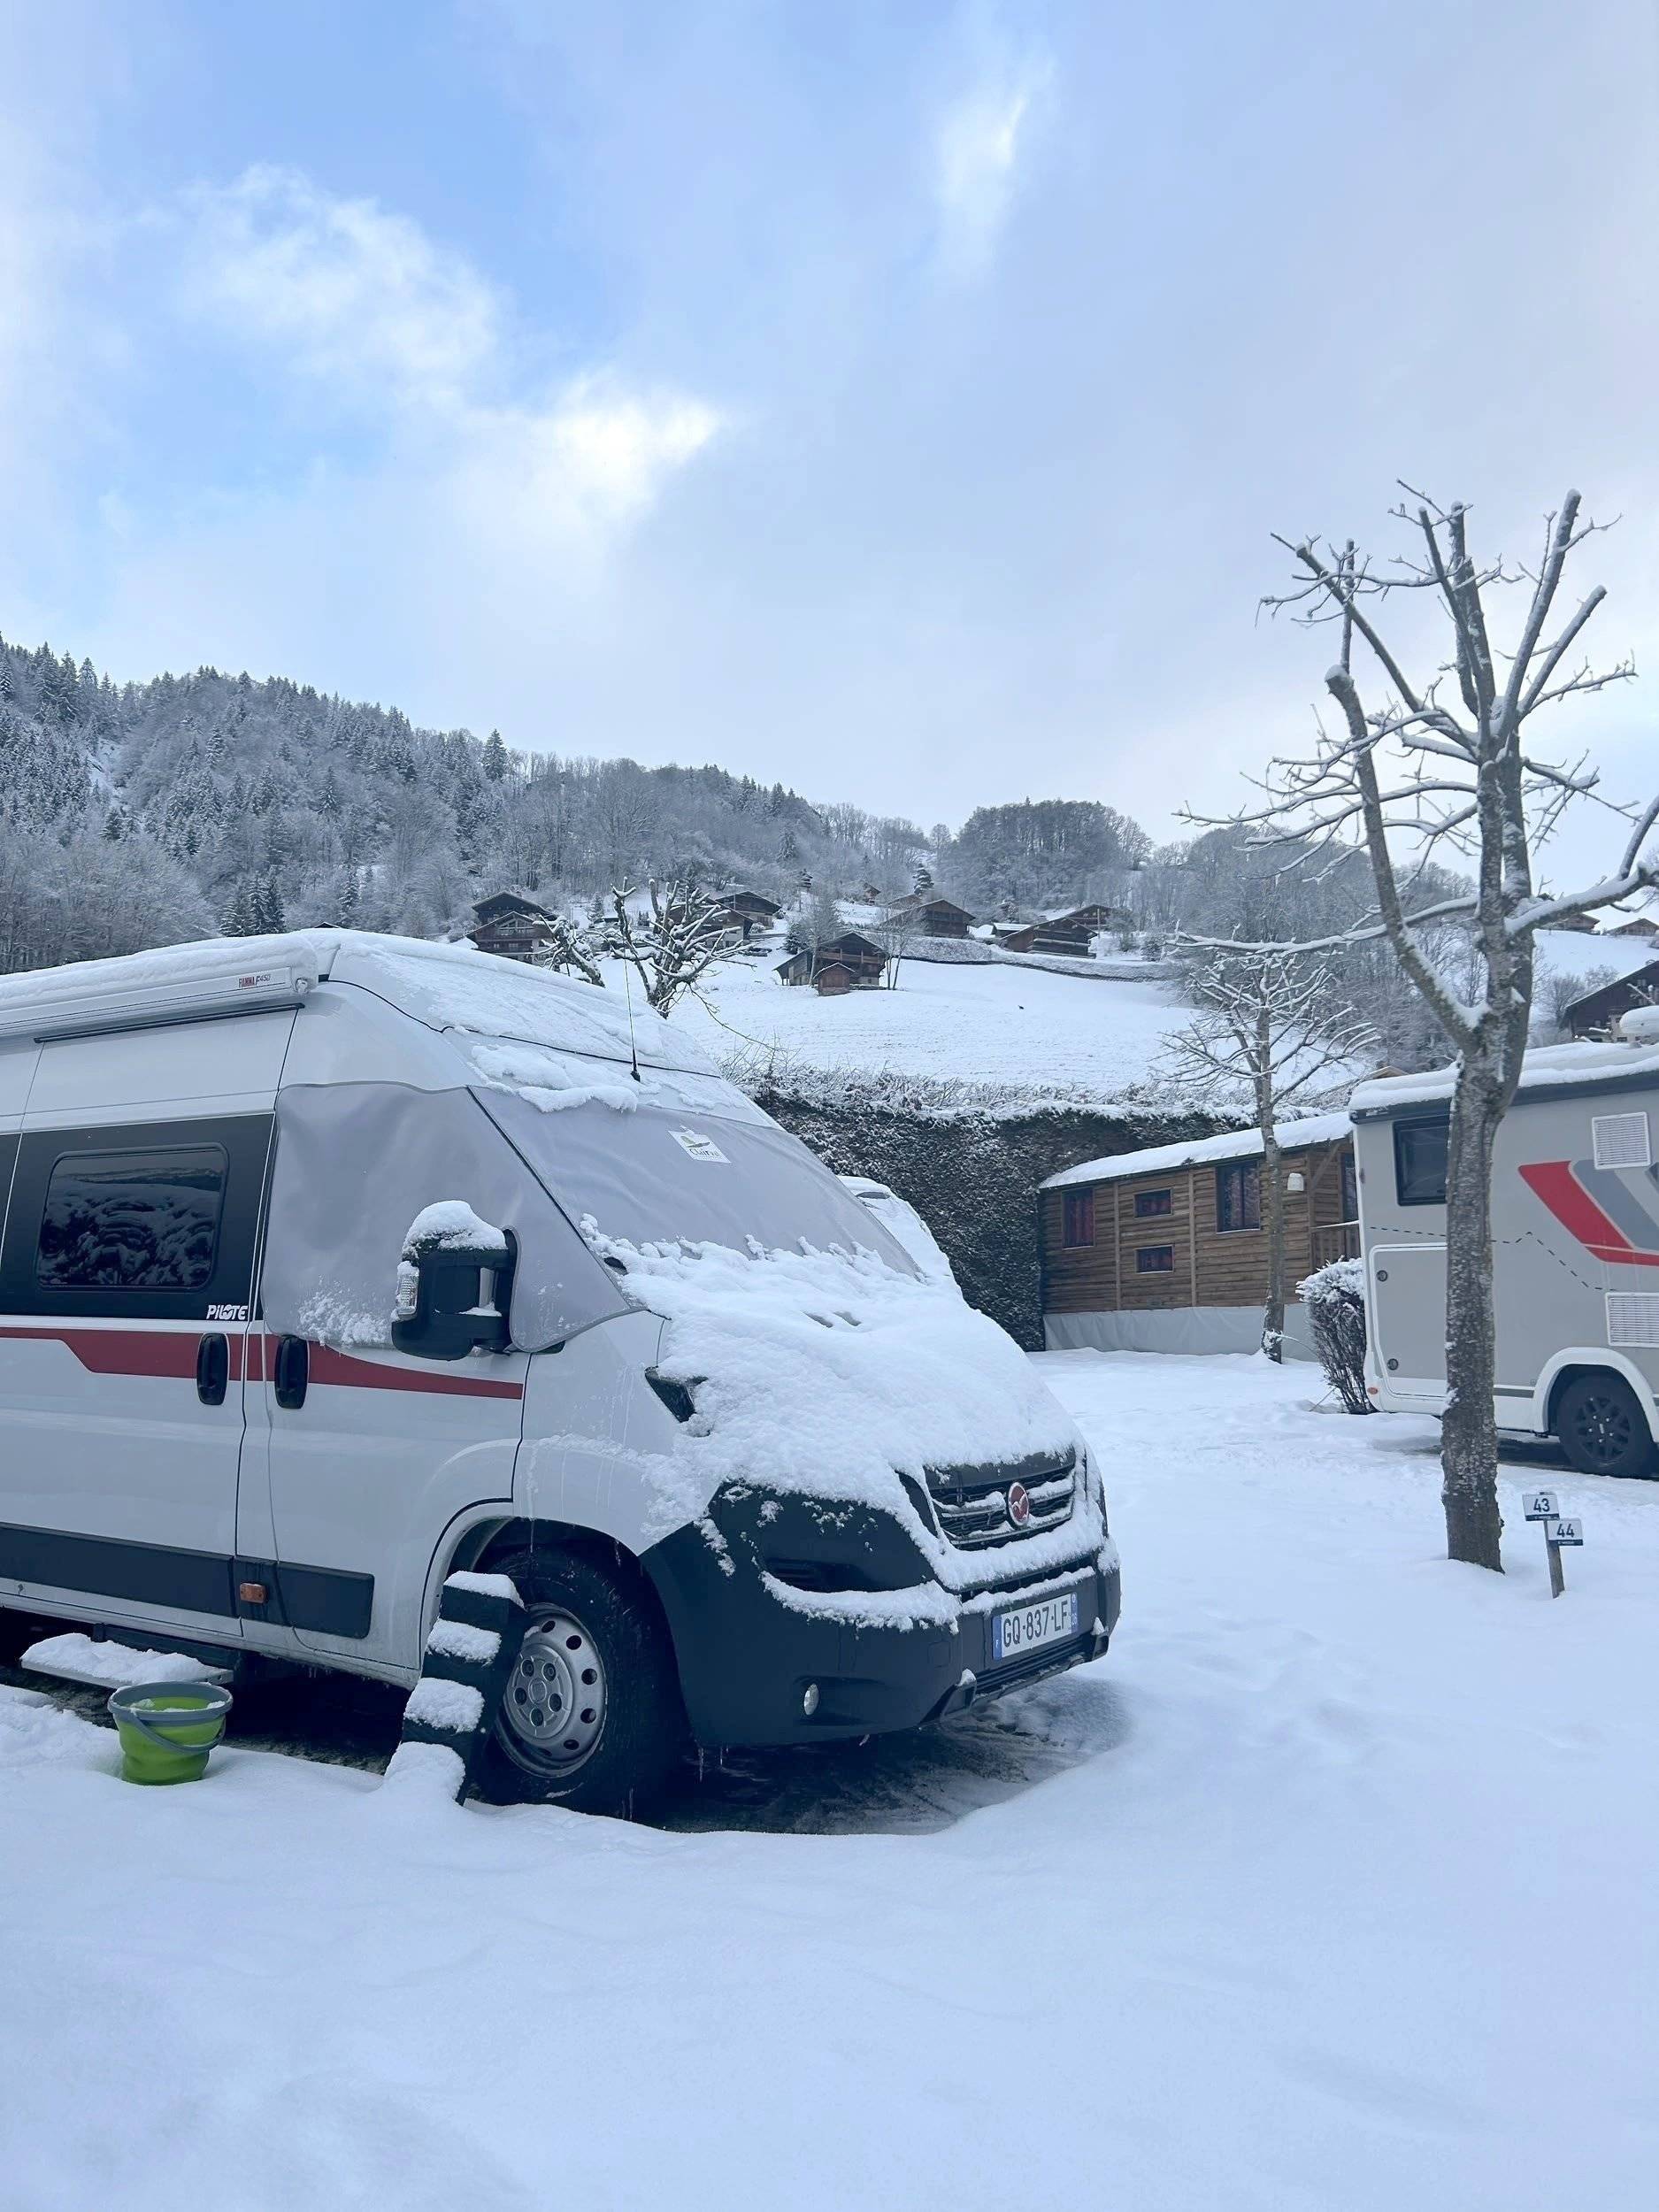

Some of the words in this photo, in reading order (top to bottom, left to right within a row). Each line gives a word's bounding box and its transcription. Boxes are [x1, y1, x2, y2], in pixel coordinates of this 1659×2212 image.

[1533, 1498, 1550, 1512] 43
[1556, 1524, 1575, 1538] 44
[1003, 1601, 1068, 1647] GQ-837-LF
